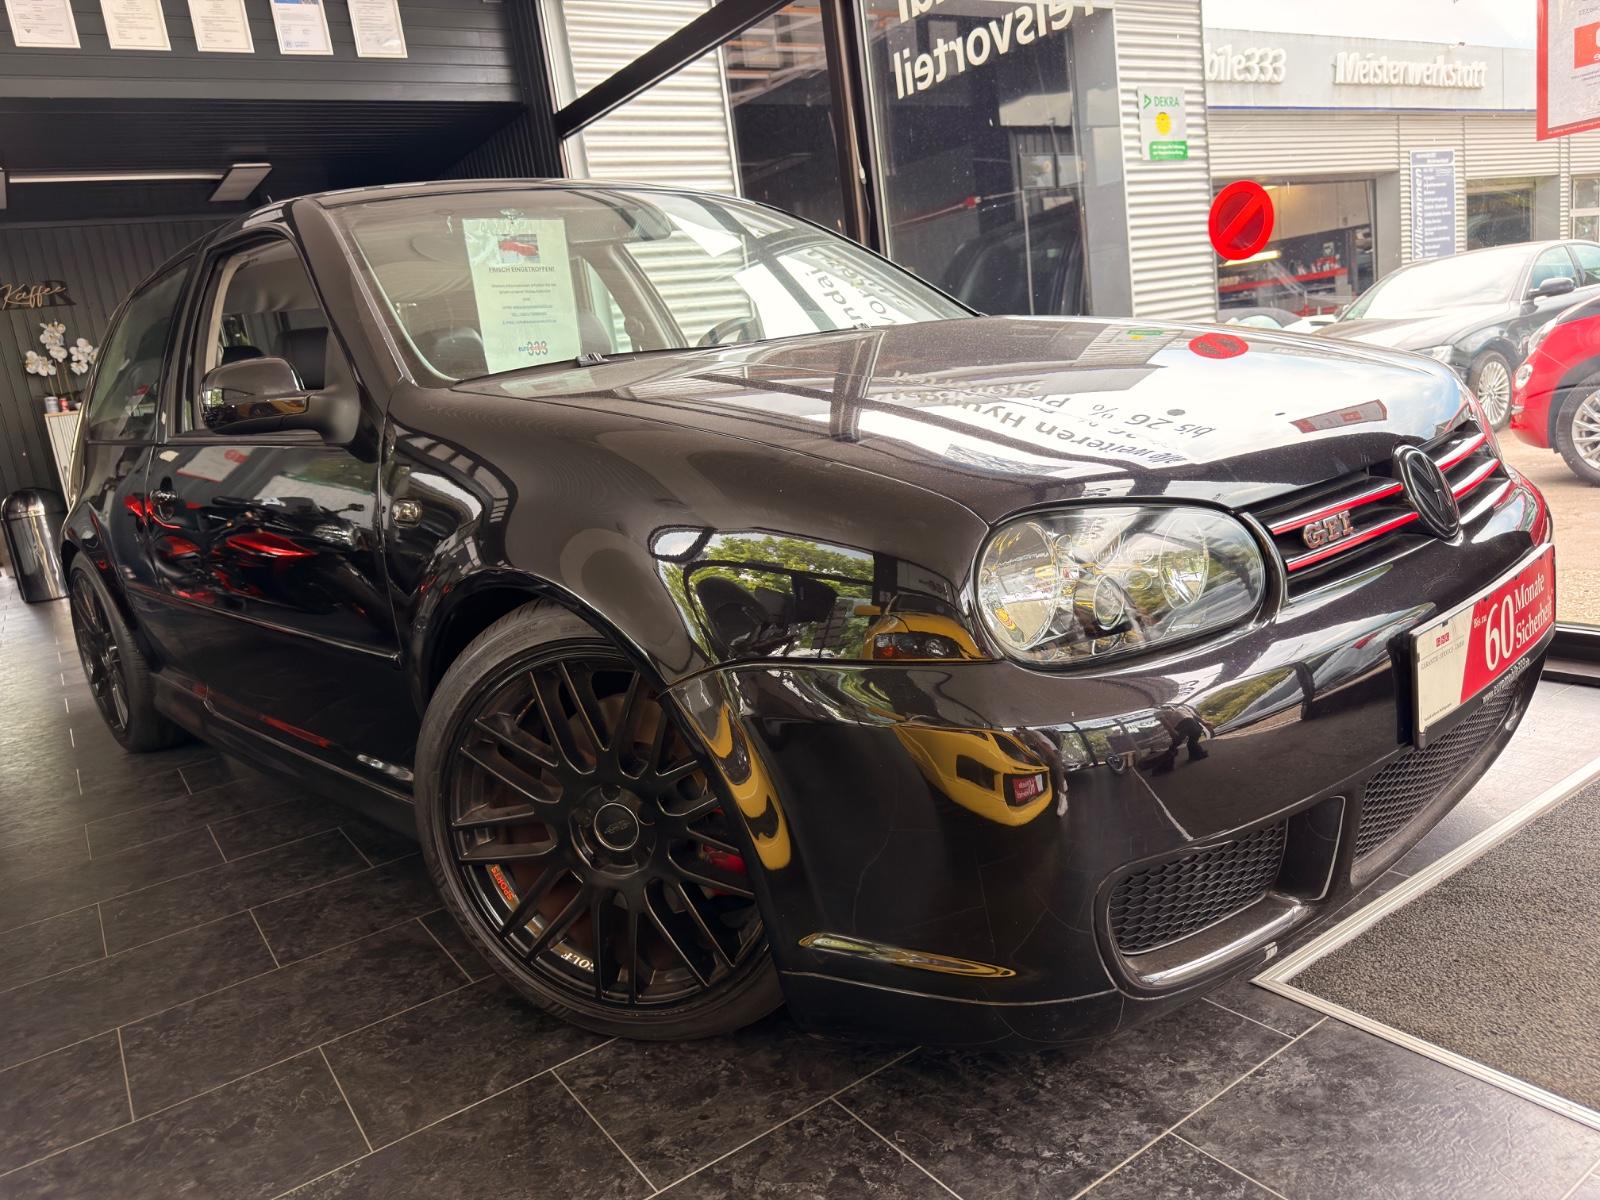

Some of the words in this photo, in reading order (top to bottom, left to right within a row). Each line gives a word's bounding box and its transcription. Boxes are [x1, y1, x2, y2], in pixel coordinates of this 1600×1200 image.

[1334, 51, 1489, 89] Meisterwerkstatt
[1153, 95, 1180, 108] DEKRA
[0, 283, 66, 311] Kaffee
[1124, 413, 1173, 430] 26
[1485, 594, 1514, 672] 60
[1515, 573, 1545, 615] Monate
